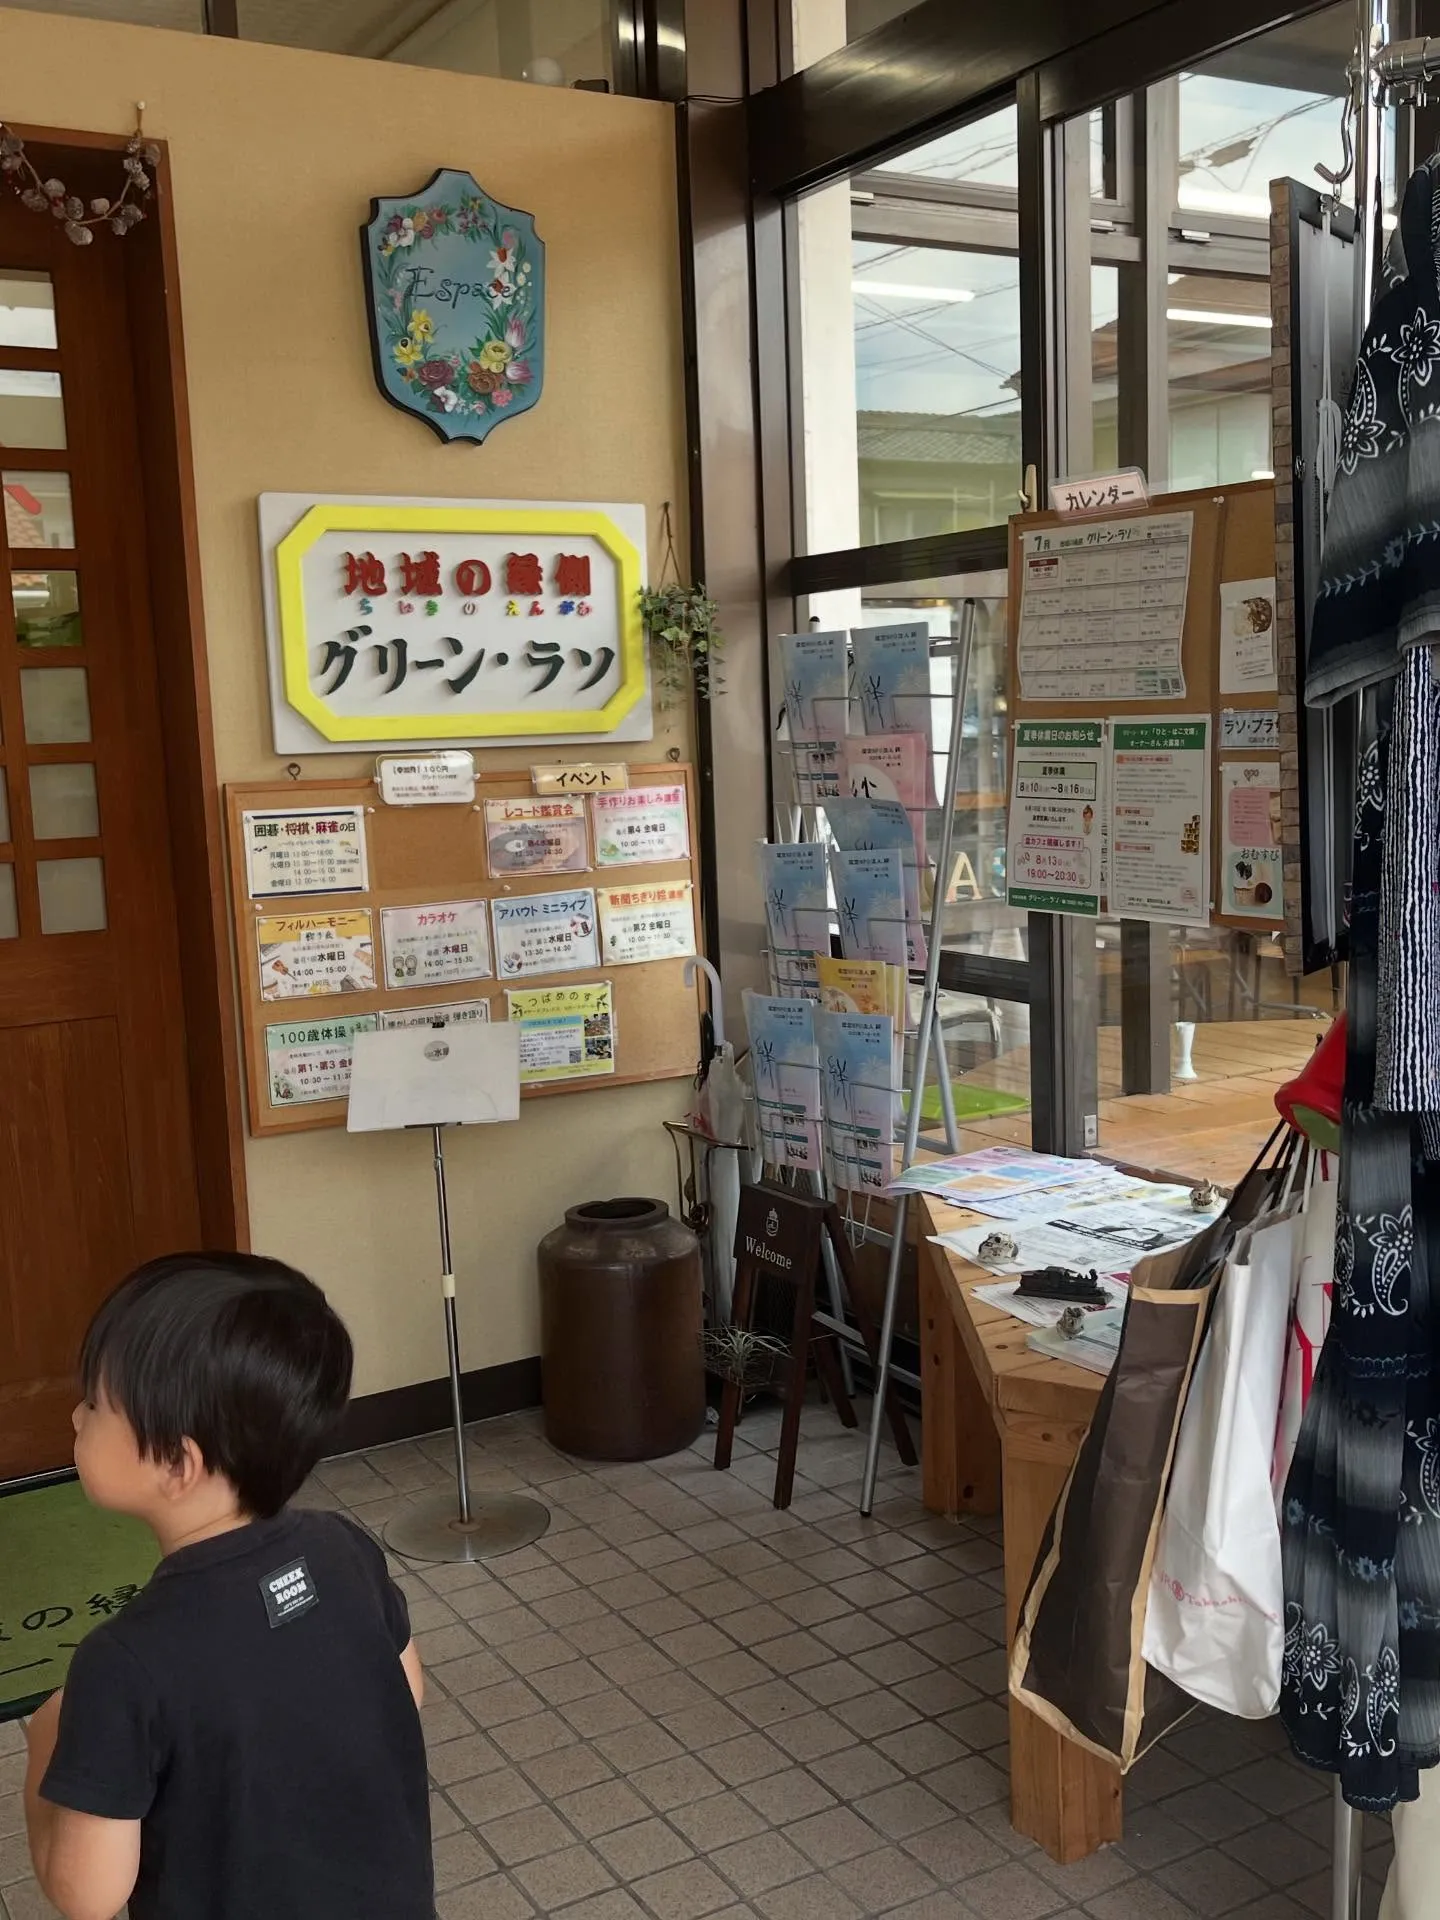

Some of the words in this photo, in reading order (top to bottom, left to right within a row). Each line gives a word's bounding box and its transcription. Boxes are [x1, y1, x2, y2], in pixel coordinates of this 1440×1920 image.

[405, 267, 512, 309] Espace
[1066, 485, 1134, 511] カレンダー
[1034, 535, 1050, 551] 7月
[319, 624, 615, 695] グリーン・ラソ
[556, 770, 611, 787] イベント
[505, 804, 574, 818] レコード鑑賞会
[254, 821, 356, 837] 囲碁・将棋・麻雀の日
[270, 851, 289, 859] 月曜日
[945, 851, 983, 903] A
[543, 900, 587, 914] ミニライブ
[276, 917, 358, 931] フィルハーモニー
[418, 911, 457, 926] カラオケ
[443, 944, 468, 954] 木曜日
[529, 991, 592, 1006] つばめのす
[280, 1026, 346, 1045] 100歳体操
[745, 1236, 792, 1269] Welcome
[275, 1580, 307, 1605] ROOM
